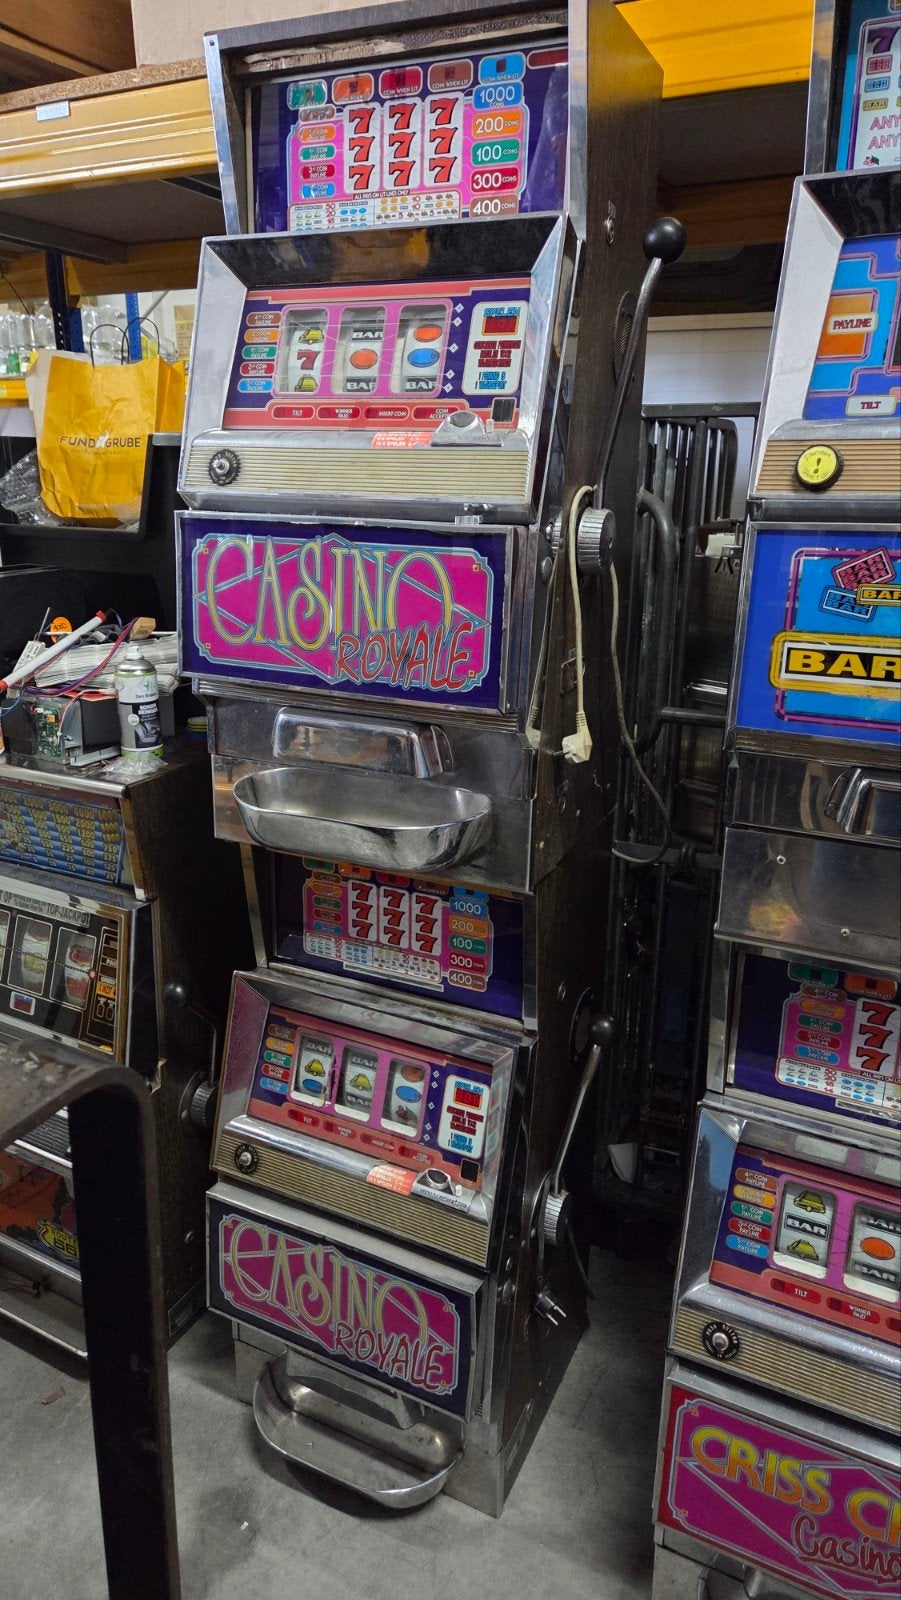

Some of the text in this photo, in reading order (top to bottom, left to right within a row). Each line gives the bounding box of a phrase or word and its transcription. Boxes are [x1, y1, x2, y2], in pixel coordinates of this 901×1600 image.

[479, 86, 515, 102] 1000
[349, 97, 458, 134] 7 7 7
[476, 116, 504, 133] 200
[348, 126, 458, 162] 7 7 7
[476, 144, 502, 160] 100
[348, 156, 457, 190] 7 7 7
[472, 171, 501, 188] 300
[472, 198, 500, 215] 400
[832, 318, 872, 330] PAYLINE
[297, 350, 321, 370] 7
[860, 401, 881, 409] TILT
[60, 435, 141, 448] FUND GRUBE
[206, 534, 453, 652] CASINO
[336, 620, 474, 690] ROYALE
[352, 881, 438, 915] 7 7 7
[454, 901, 481, 914] 1000
[352, 901, 373, 920] 7
[383, 907, 405, 927] 7
[415, 914, 438, 934] 7
[451, 919, 474, 932] 200
[352, 919, 373, 939] 7
[383, 926, 405, 946] 7
[415, 933, 438, 953] 7
[453, 937, 472, 950] 100
[450, 954, 473, 968] 300
[450, 973, 472, 985] 400
[861, 1001, 897, 1026] 7
[859, 1024, 894, 1050] 7
[856, 1046, 890, 1072] 7
[745, 1177, 766, 1188] PAYLINE
[754, 1174, 768, 1182] COIN
[741, 1211, 762, 1220] PAYLINE
[750, 1206, 764, 1214] COIN
[739, 1228, 760, 1238] PAYLINE
[748, 1224, 762, 1232] COIN
[787, 1218, 827, 1236] BAR
[737, 1244, 758, 1254] PAYLINE
[747, 1241, 761, 1249] COIN
[854, 1263, 896, 1282] BAR
[231, 1221, 429, 1341] CASINO
[794, 1288, 808, 1298] TILT
[849, 1304, 871, 1317] WINNER
[335, 1322, 444, 1392] ROYALE
[690, 1427, 831, 1514] CRISS
